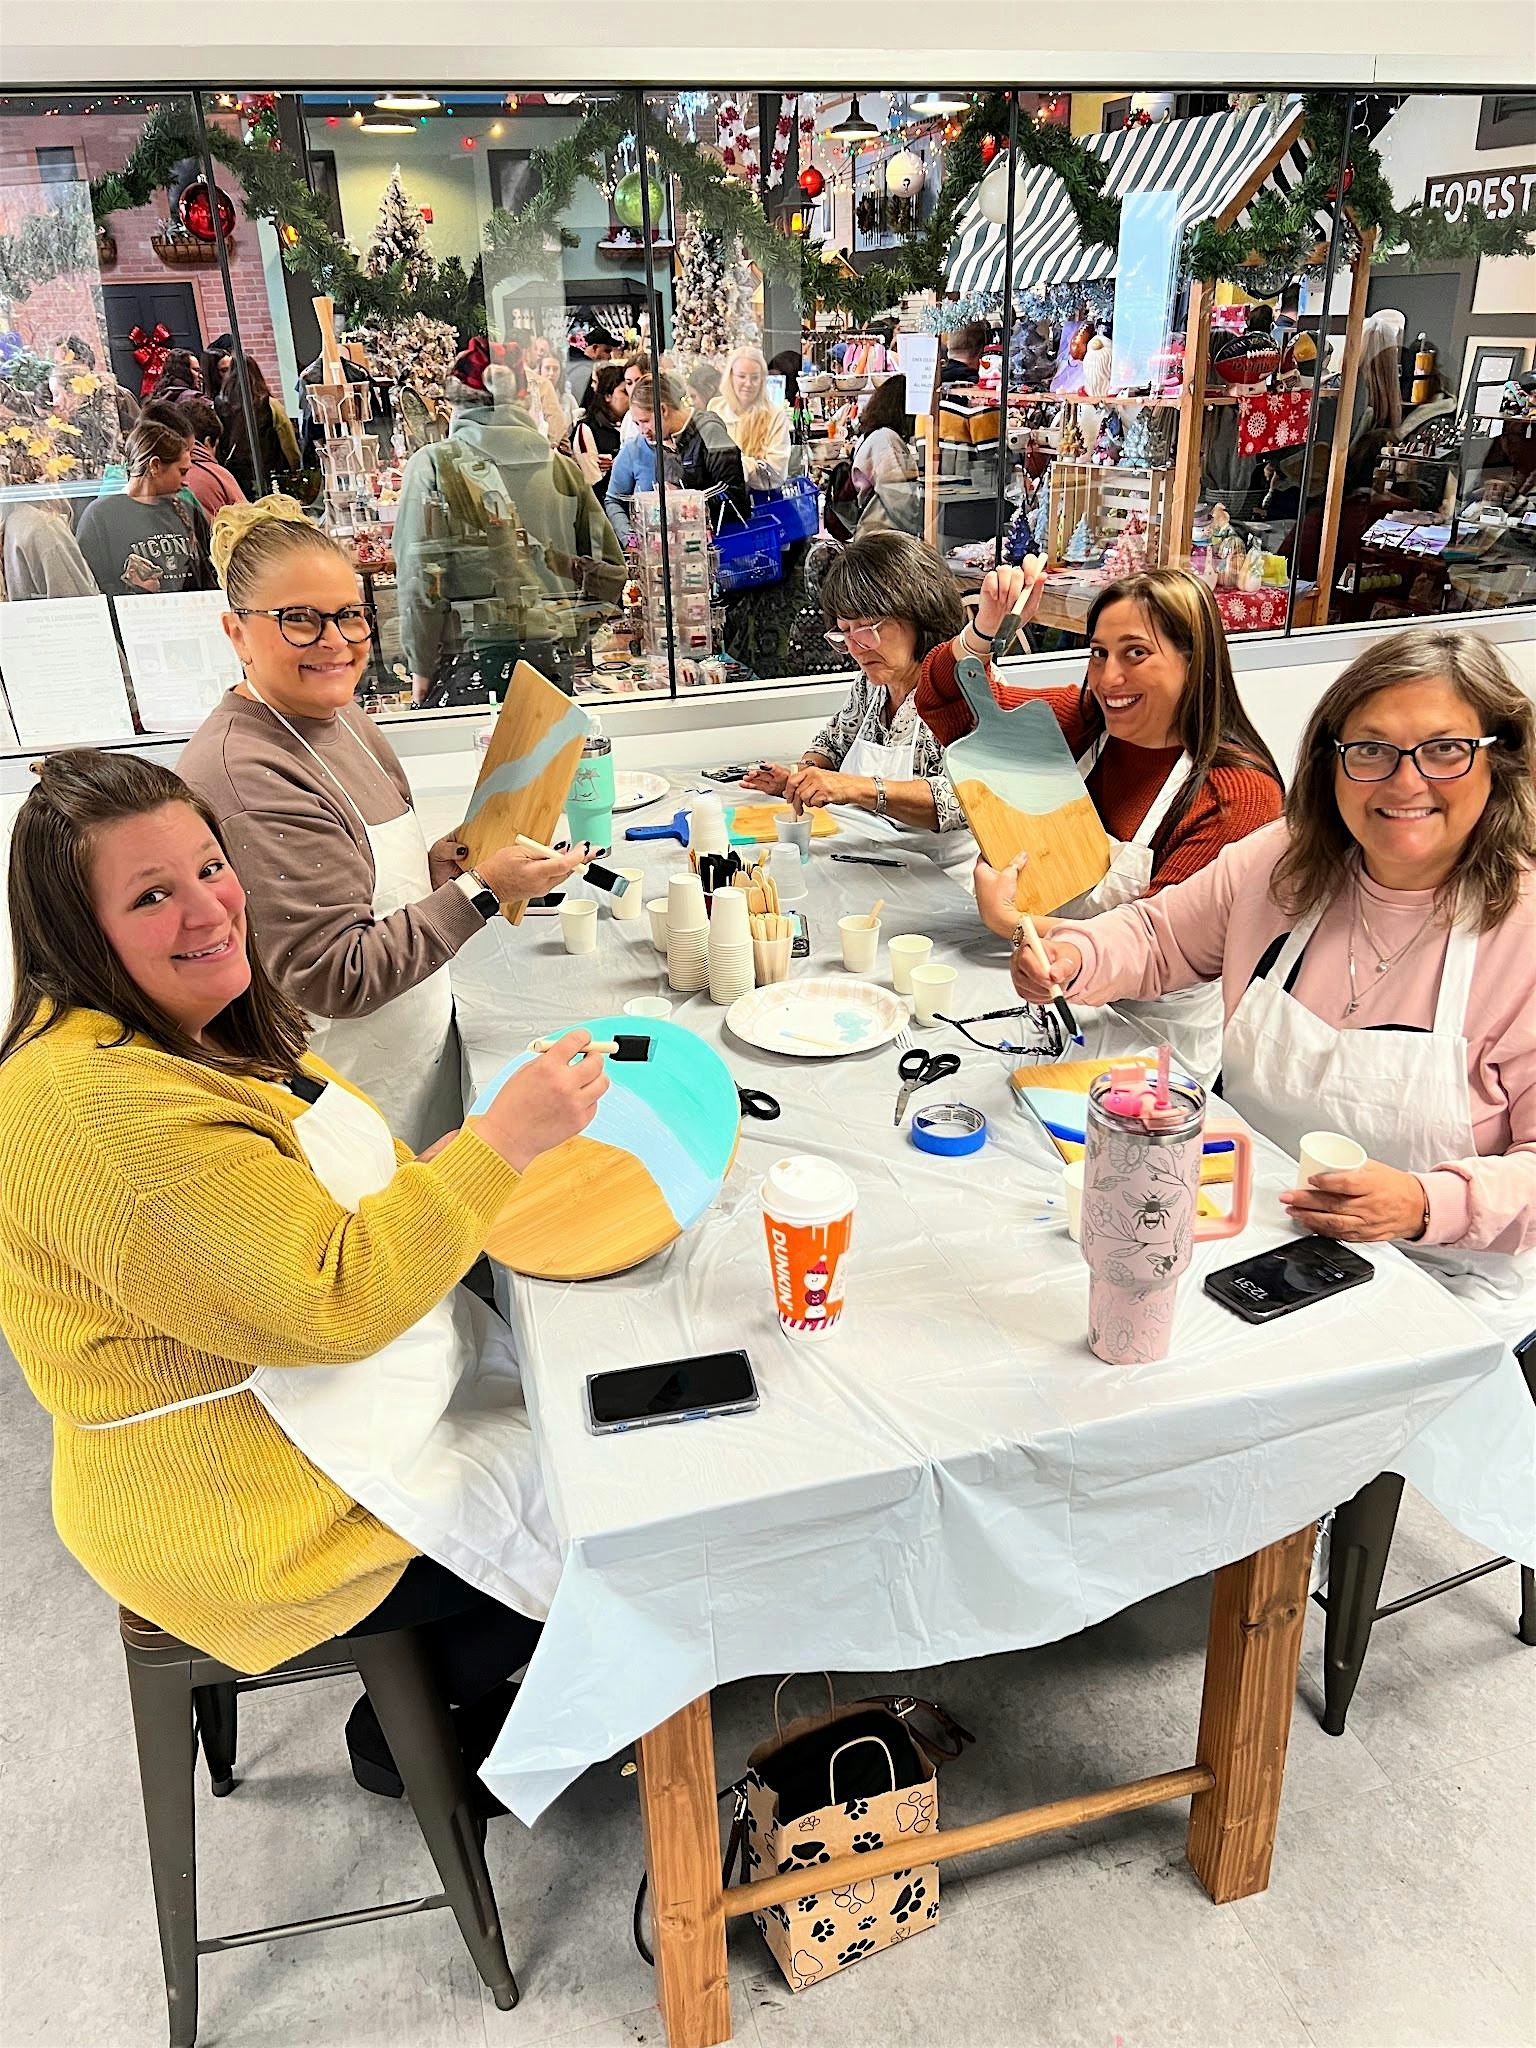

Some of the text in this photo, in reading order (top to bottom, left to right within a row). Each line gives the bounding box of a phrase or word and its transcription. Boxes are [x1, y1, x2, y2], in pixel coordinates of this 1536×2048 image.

[131, 537, 196, 559] UCON
[771, 1227, 794, 1312] DUNKIN'
[1233, 1276, 1269, 1300] 12:31
